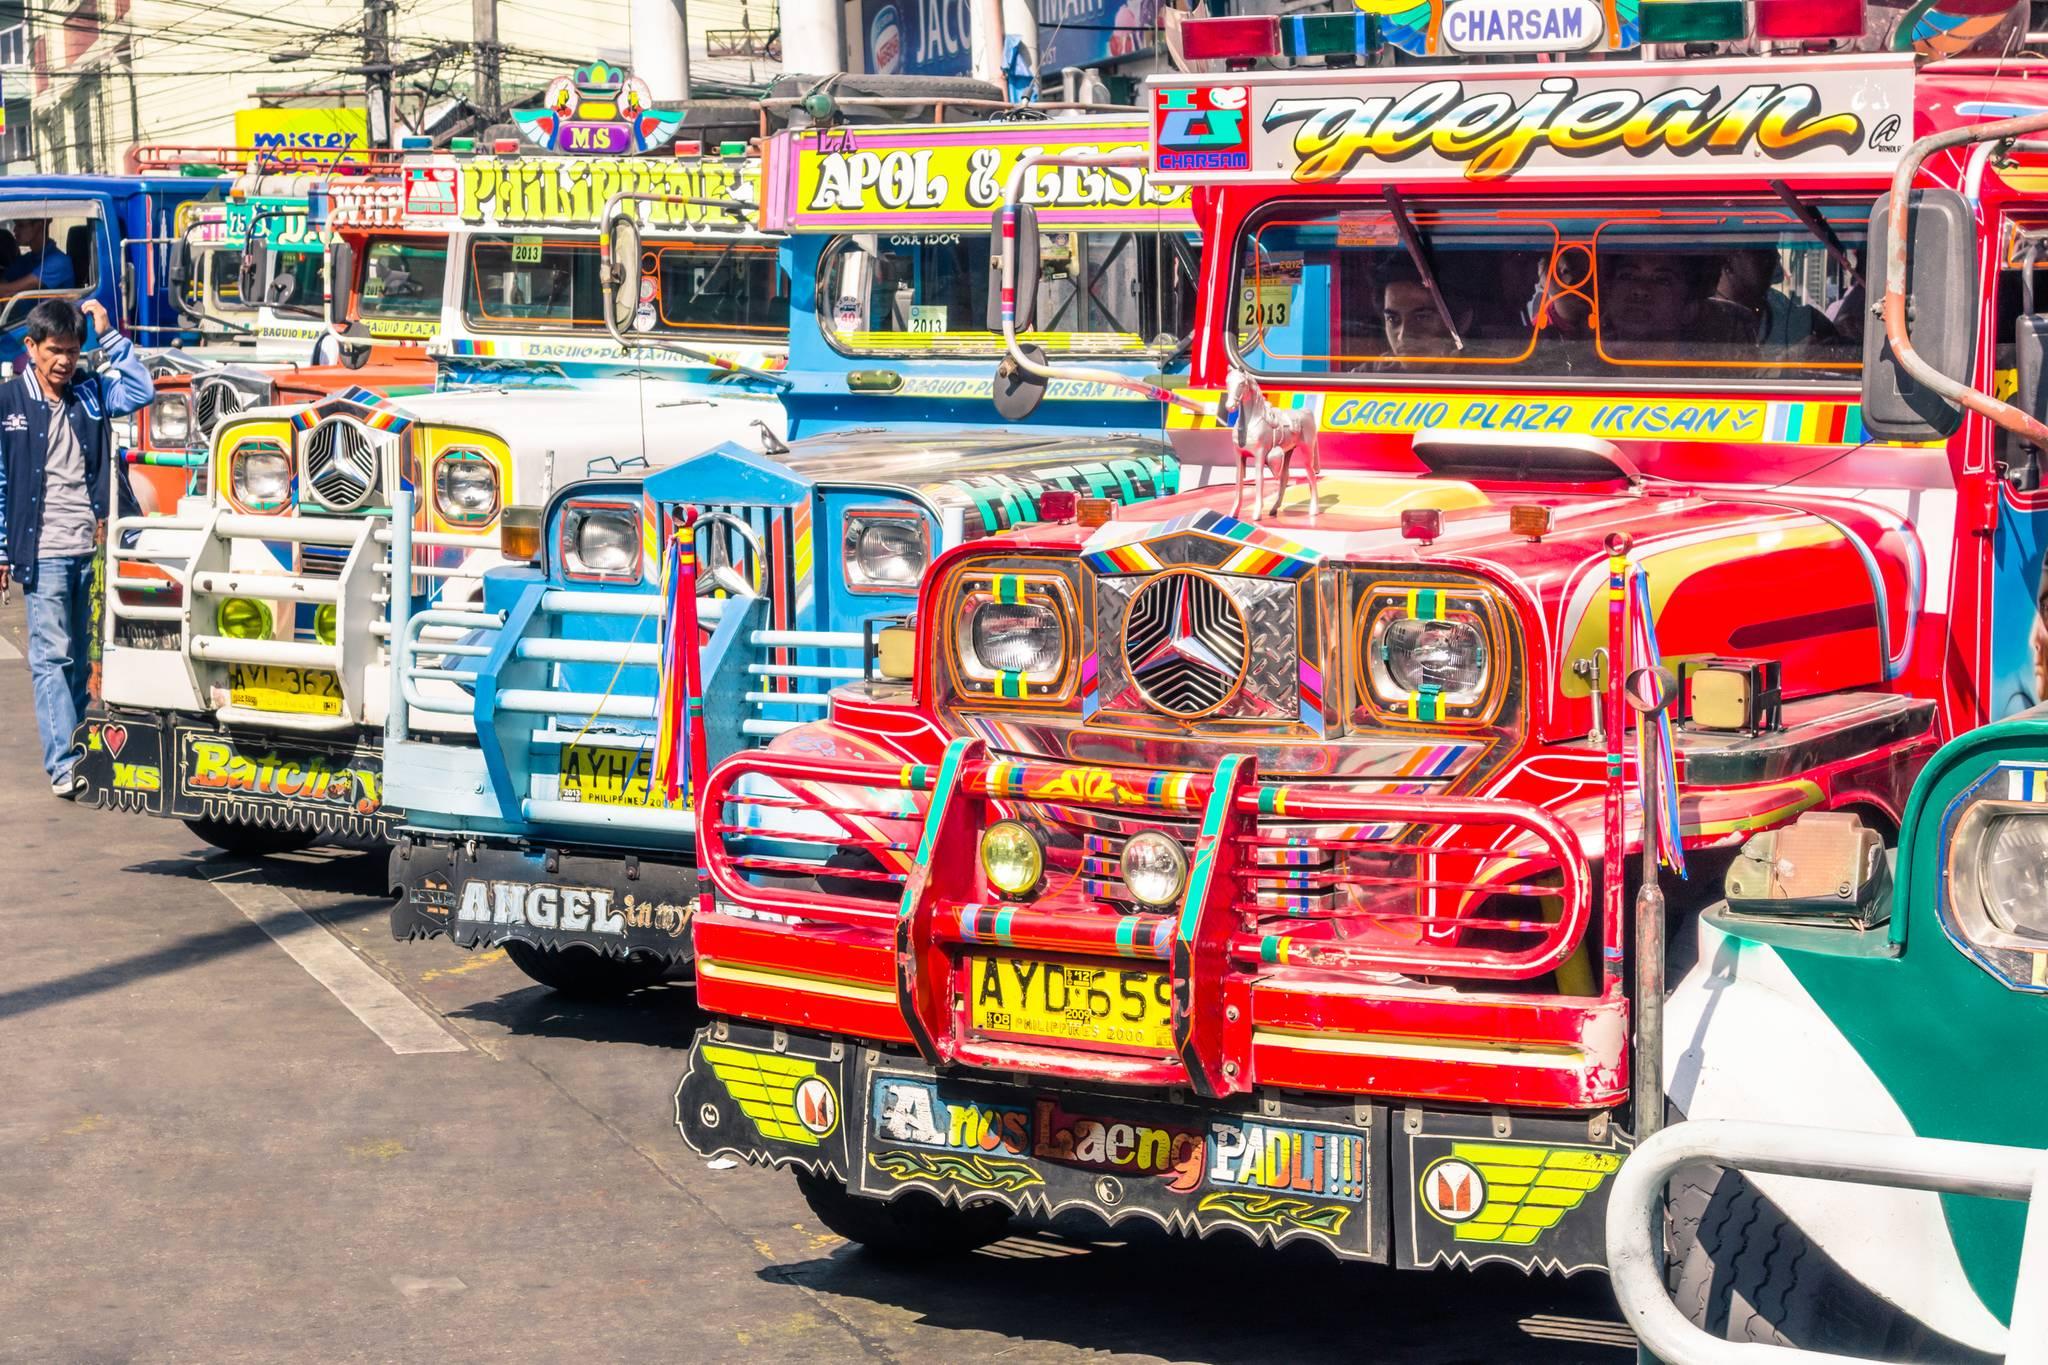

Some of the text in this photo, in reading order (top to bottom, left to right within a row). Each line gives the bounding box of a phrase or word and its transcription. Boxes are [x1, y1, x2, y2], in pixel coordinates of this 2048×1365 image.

[1449, 7, 1582, 42] CHARSAM
[1160, 152, 1247, 169] CHARSAM
[809, 147, 949, 209] APOL
[969, 148, 1001, 207] &
[515, 245, 539, 260] 2013
[913, 318, 942, 333] 2013
[1245, 302, 1286, 325] 2013
[263, 327, 298, 339] BAGUIO
[1330, 400, 1731, 432] BAGUIO PLAZA IRISAN
[286, 668, 334, 696] 362
[113, 762, 160, 791] MS
[564, 747, 627, 791] AYH
[563, 788, 581, 797] 2013
[458, 880, 625, 934] ANGEL
[624, 894, 652, 929] in
[993, 1013, 1010, 1024] 08
[1035, 1098, 1205, 1192] Laeng
